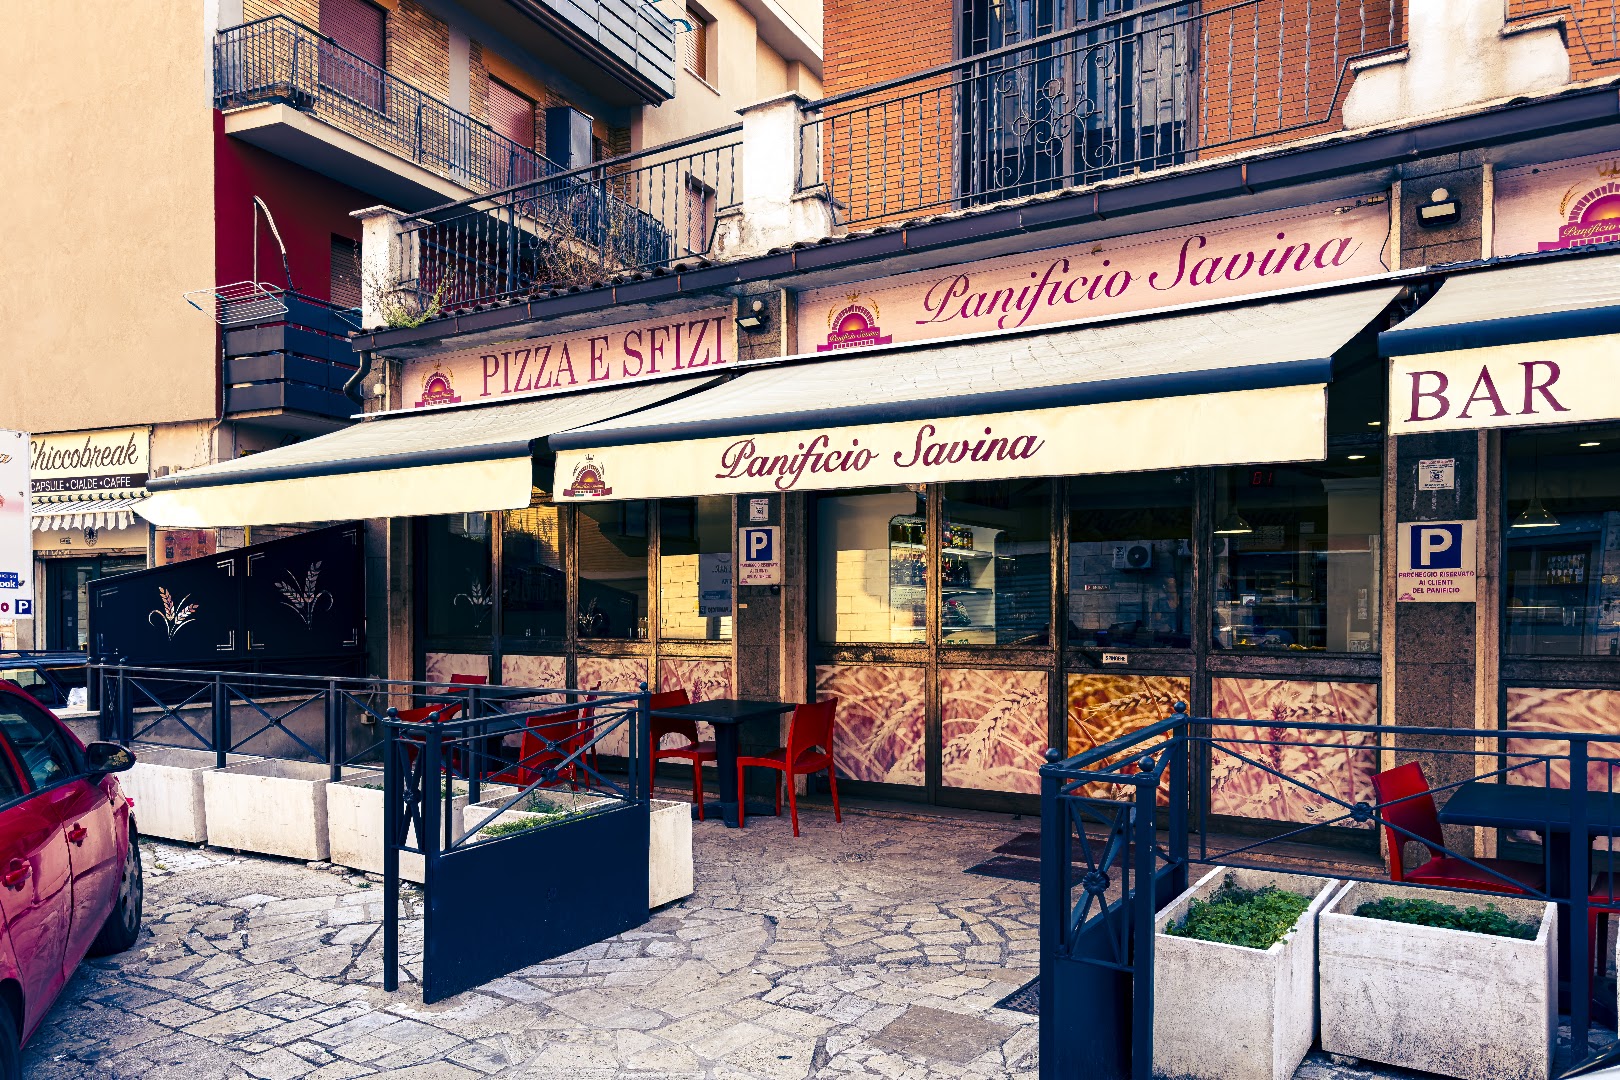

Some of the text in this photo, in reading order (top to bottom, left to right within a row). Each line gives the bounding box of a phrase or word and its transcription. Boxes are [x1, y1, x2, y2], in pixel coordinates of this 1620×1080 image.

[916, 232, 1363, 330] Panificio Savina
[480, 315, 727, 397] PIZZA E SFIZI
[1403, 360, 1572, 423] BAR
[715, 424, 1046, 491] Panificio Savina
[31, 476, 131, 492] CAPSULE CIALDE CAFFE
[750, 531, 768, 559] P
[1420, 528, 1453, 566] P
[18, 600, 29, 613] P
